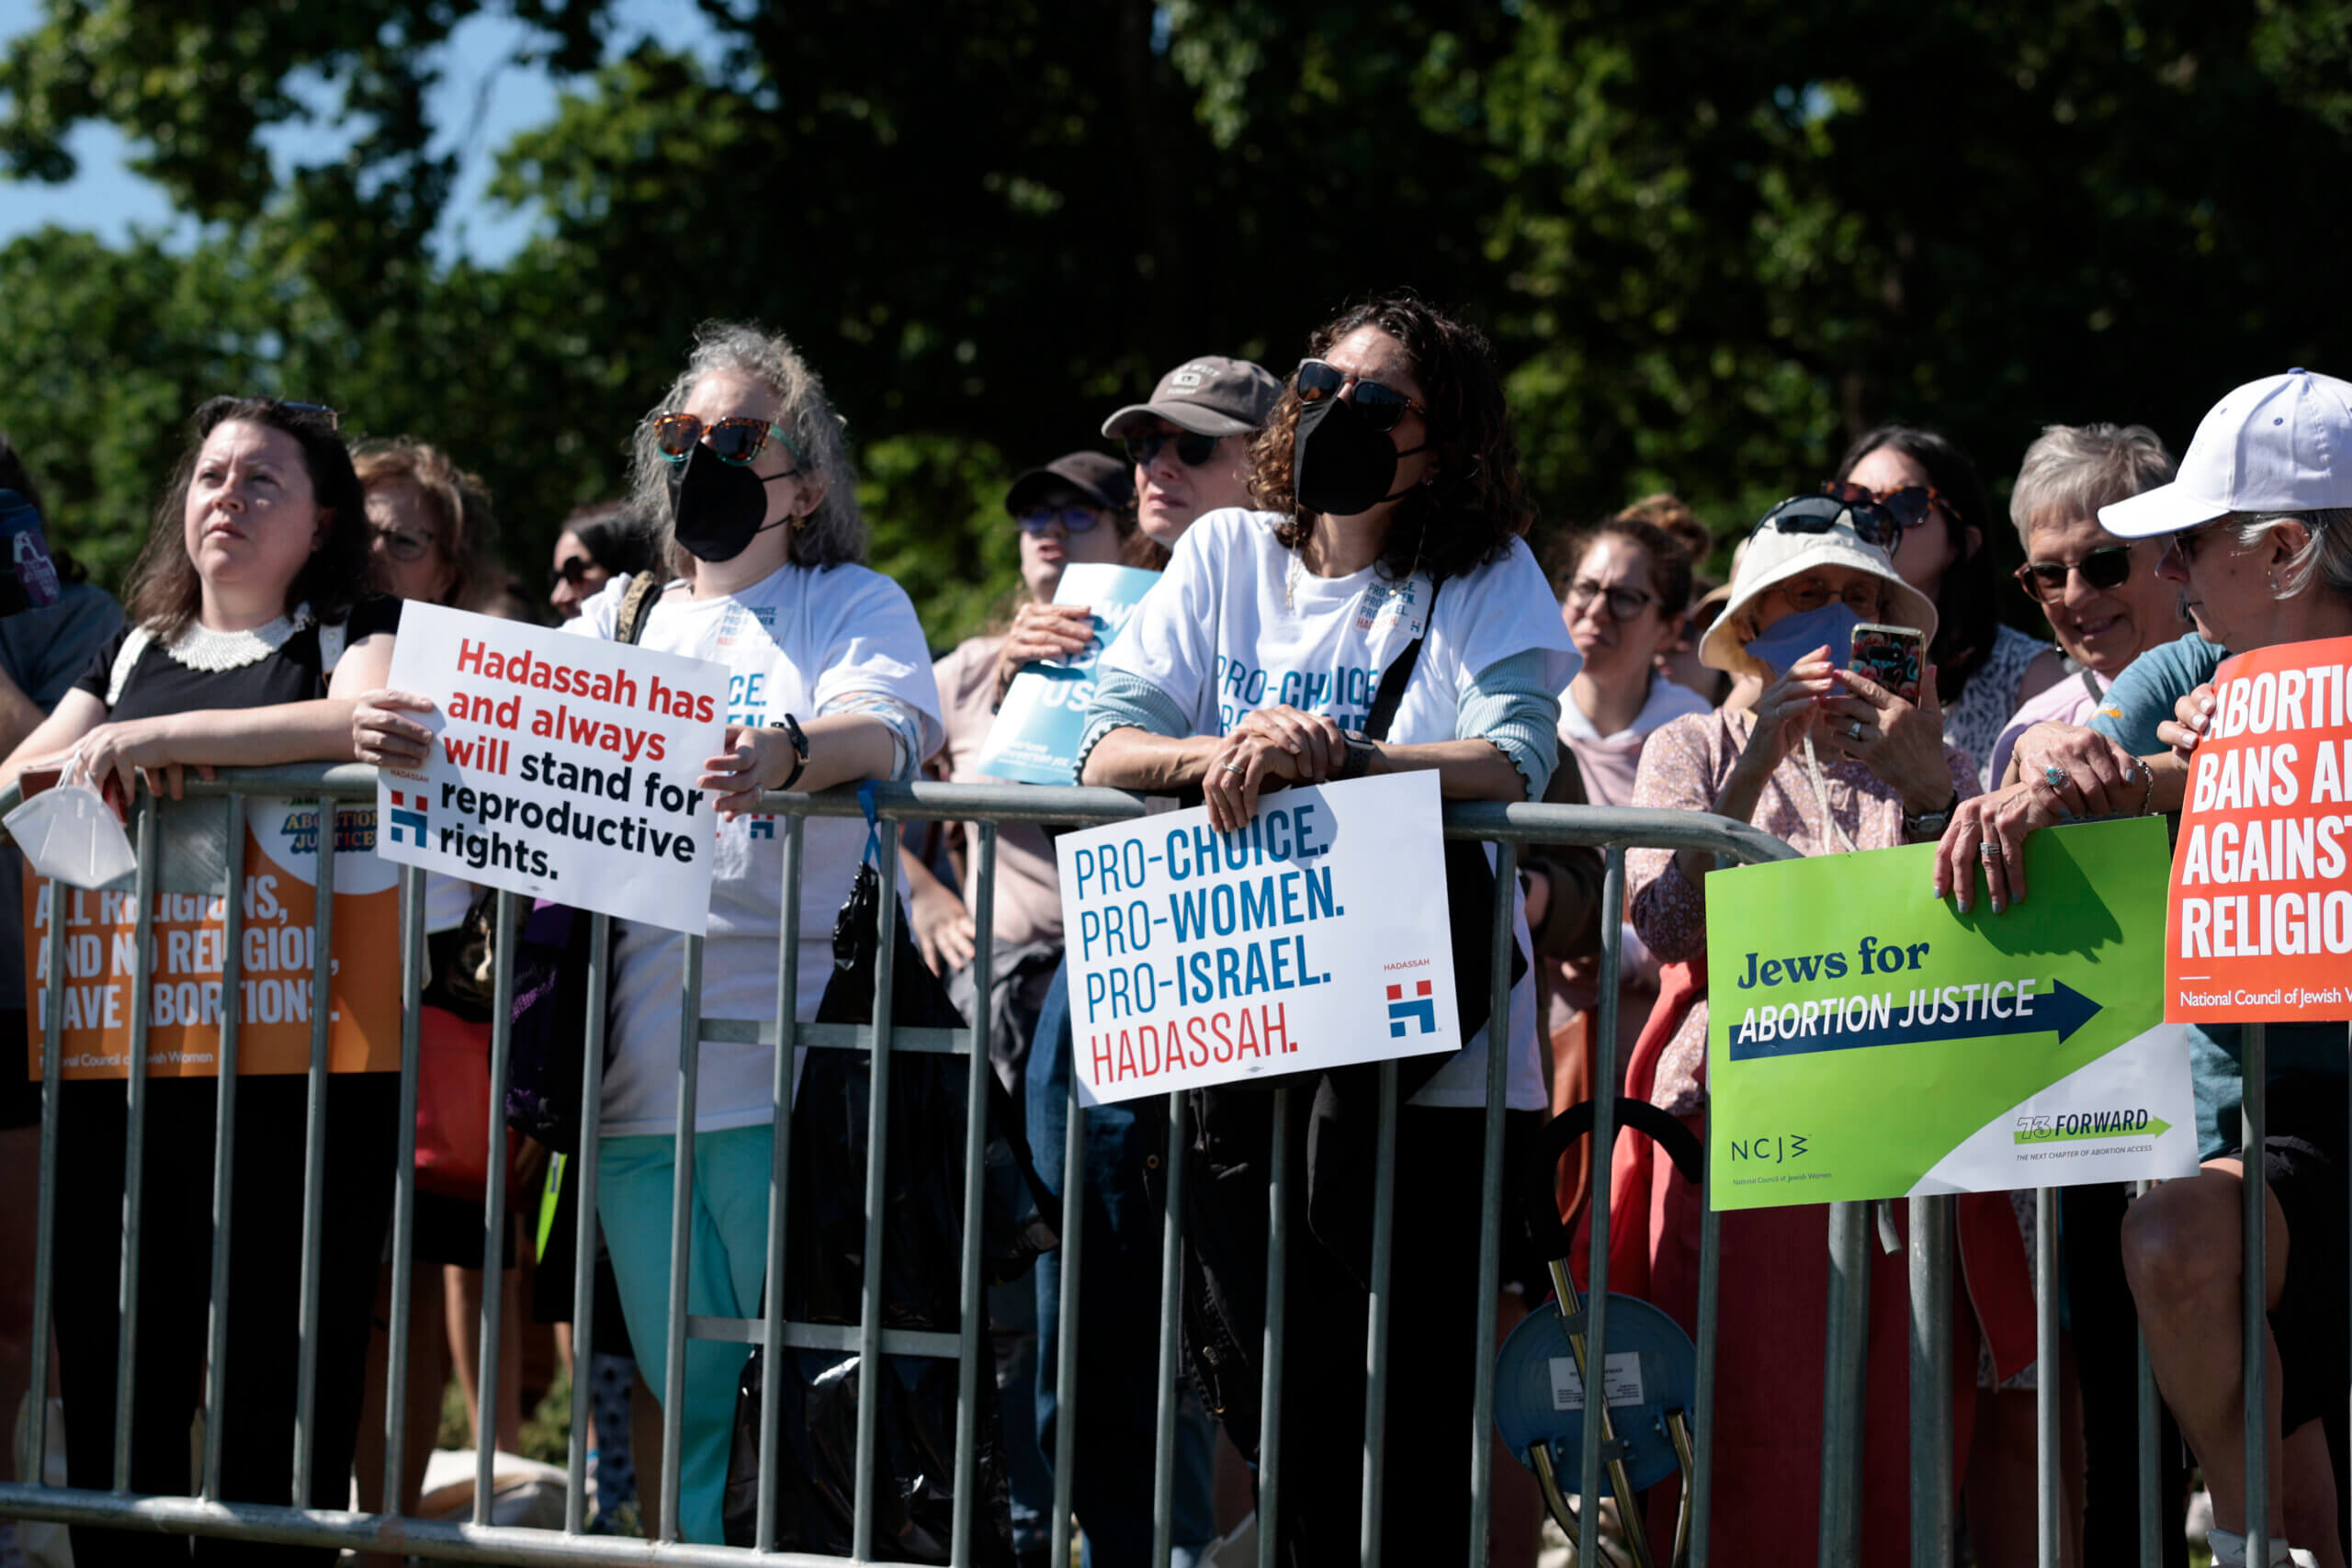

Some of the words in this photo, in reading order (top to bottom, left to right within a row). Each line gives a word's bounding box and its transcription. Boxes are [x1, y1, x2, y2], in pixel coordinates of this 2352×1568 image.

[457, 638, 637, 707] Hadassah
[648, 676, 715, 723] has
[2202, 665, 2352, 742] ABORTI
[448, 692, 522, 730] and
[531, 705, 666, 761] always
[444, 738, 509, 775] will
[520, 752, 632, 802] stand
[645, 773, 704, 817] for
[2192, 743, 2299, 813] BANS
[293, 829, 376, 852] JUTICE
[440, 823, 558, 880] rights.
[442, 782, 695, 863] reproductive
[1075, 805, 1329, 900] PRO-CHOICE.
[1080, 866, 1344, 962] PRO-WOMEN.
[1086, 935, 1331, 1024] PRO-ISRAEL.
[1384, 958, 1430, 972] HADASSAH
[1737, 951, 1849, 990] Jews
[1858, 936, 1930, 976] for
[1737, 992, 1892, 1045] ABORTION
[1899, 978, 2037, 1029] JUSTICE
[2180, 992, 2232, 1007] National
[2234, 989, 2280, 1005] Council
[2284, 988, 2299, 1003] of
[2299, 988, 2342, 1009] Jewish
[1091, 1002, 1298, 1086] HADASSAH.
[2017, 1116, 2052, 1140] 73
[2055, 1109, 2148, 1136] FORWARD
[2030, 1152, 2048, 1161] NEXT
[2049, 1150, 2078, 1159] CHAPTER
[2091, 1147, 2125, 1156] ABORTION
[2127, 1145, 2153, 1153] ACCESS
